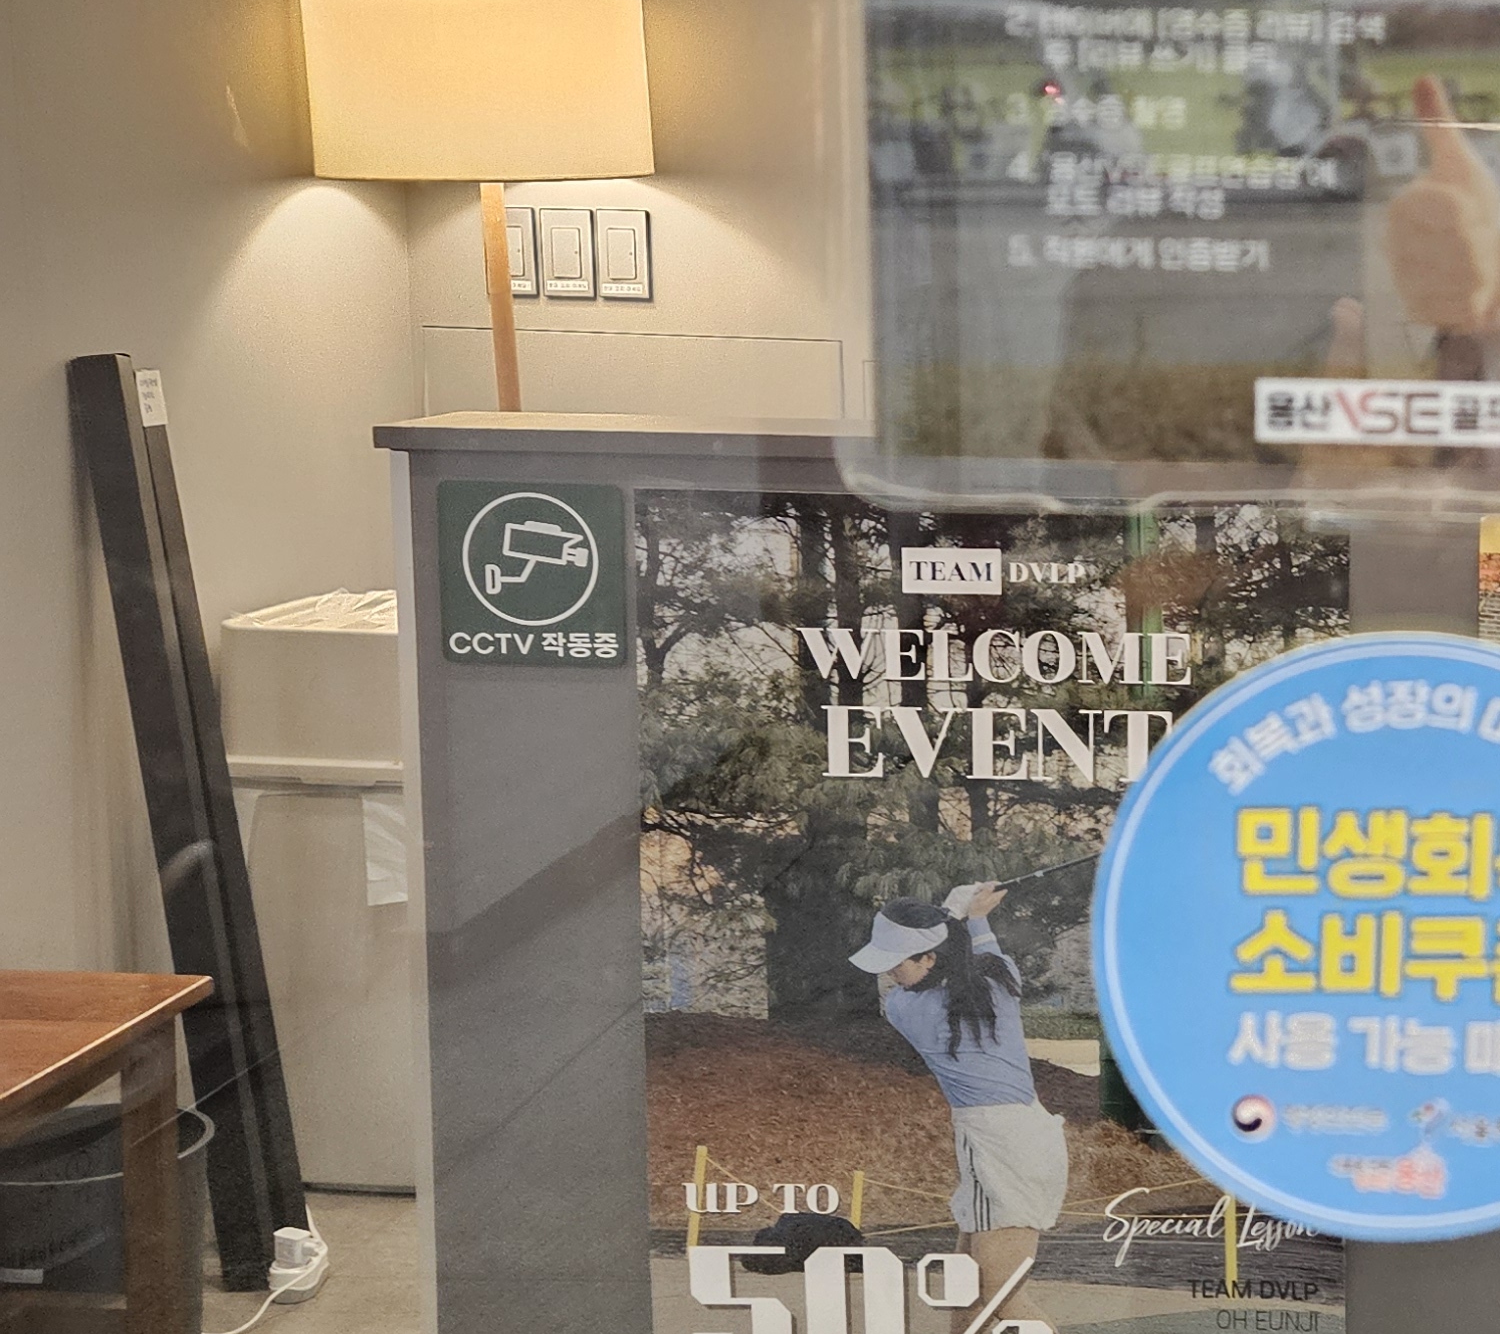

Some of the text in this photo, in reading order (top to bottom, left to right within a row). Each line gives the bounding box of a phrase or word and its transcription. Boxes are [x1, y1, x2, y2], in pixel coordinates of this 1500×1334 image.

[908, 558, 1087, 585] TEAM DVLP
[449, 632, 619, 658] CCTV 작동중
[796, 626, 1193, 686] WELCOME
[821, 704, 1173, 782] EVENT
[1208, 694, 1338, 797] 회복과
[1340, 679, 1478, 733] 성장의
[1227, 1012, 1338, 1070] 사용
[1350, 1015, 1457, 1077] 가능
[682, 1182, 839, 1216] UP TO
[1103, 1187, 1231, 1267] Special
[1187, 1279, 1319, 1301] TEAM DVLP
[1216, 1310, 1248, 1330] OH
